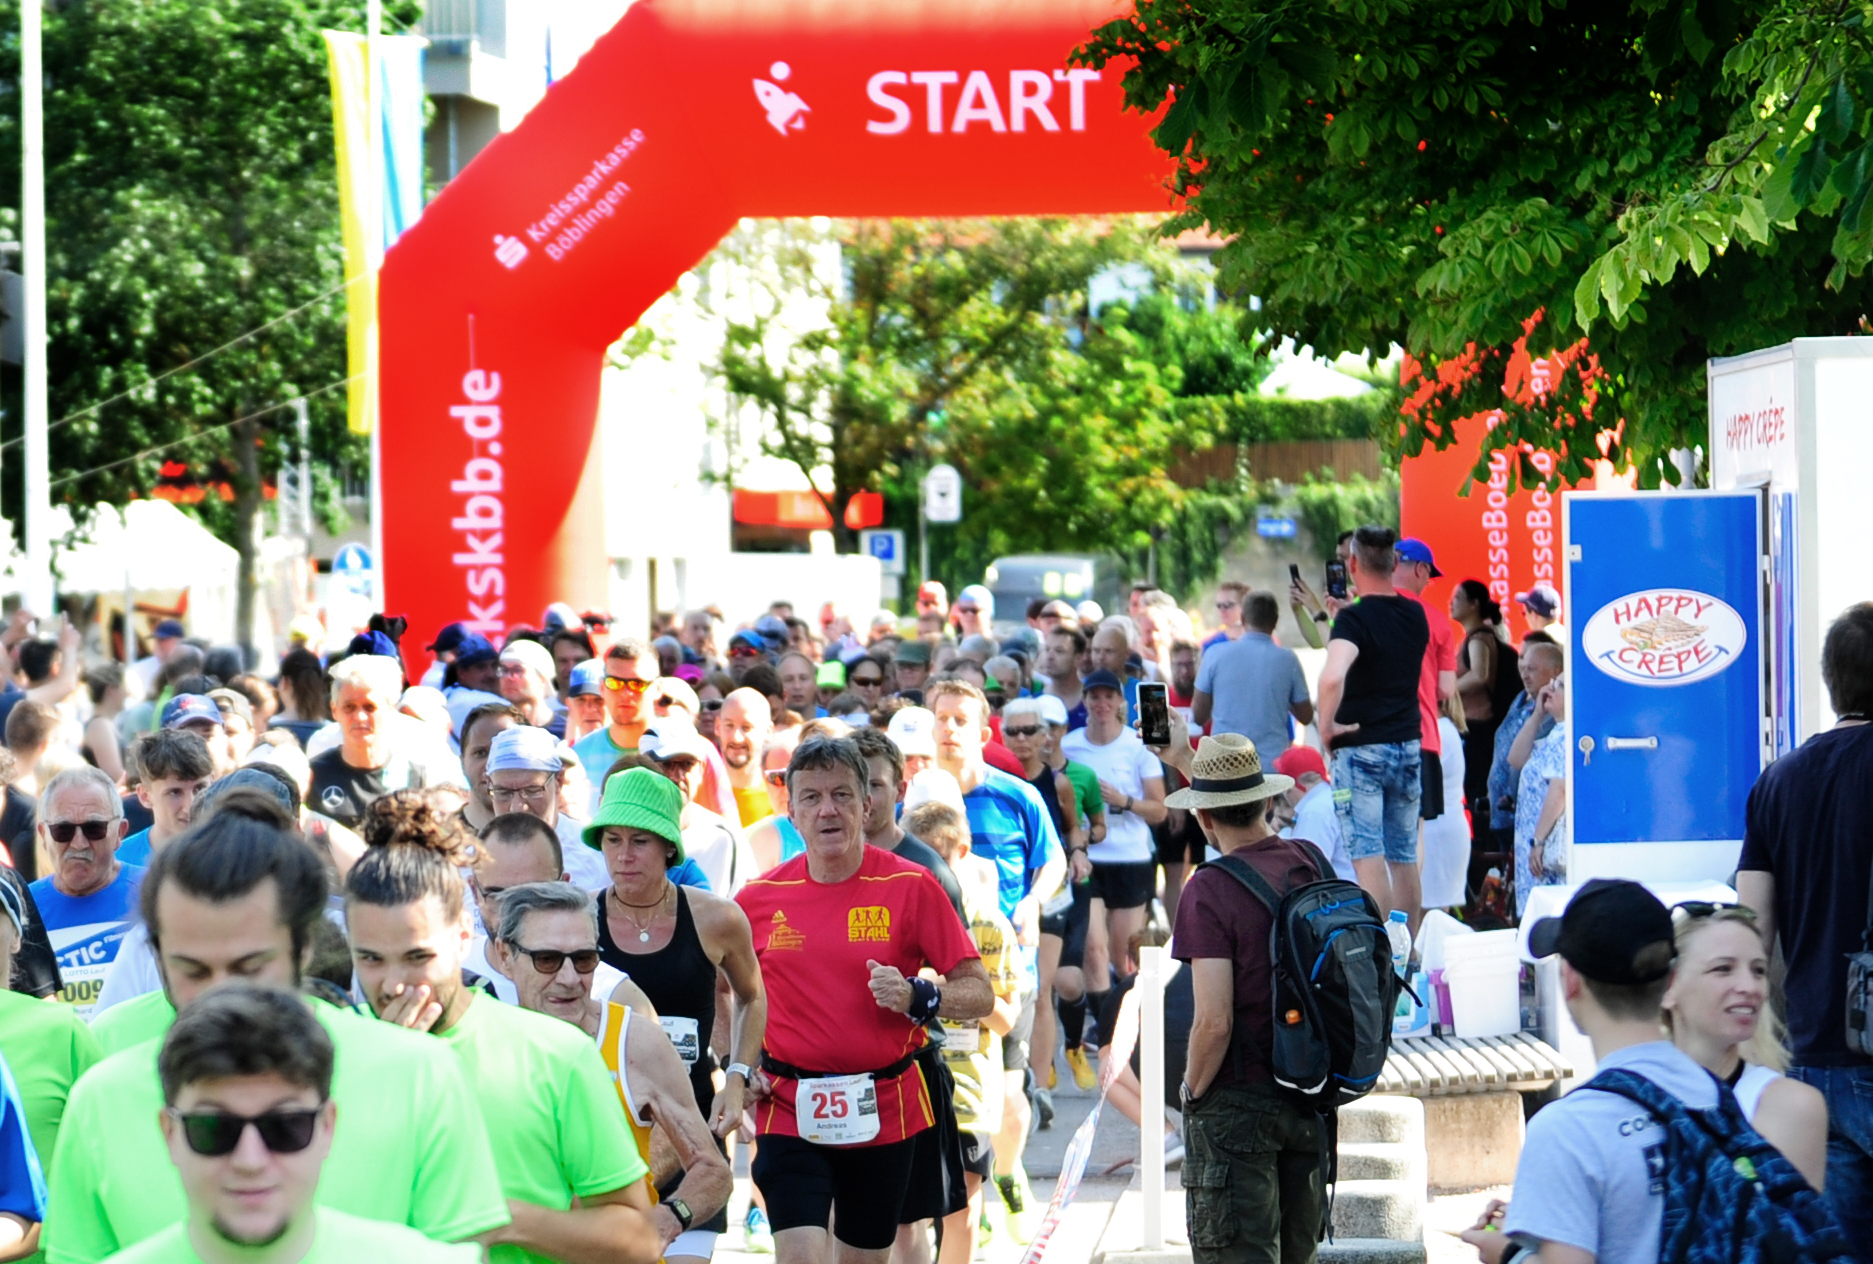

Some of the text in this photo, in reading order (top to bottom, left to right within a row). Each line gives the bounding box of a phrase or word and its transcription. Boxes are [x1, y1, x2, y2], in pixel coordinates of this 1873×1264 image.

[866, 69, 1102, 135] START
[526, 128, 645, 242] Kreissparkasse
[545, 181, 631, 261] Böblingen
[1726, 396, 1785, 451] HAPPY CRÊPE
[1613, 594, 1714, 625] HAPPY
[1618, 638, 1713, 676] CRÊPE
[848, 927, 889, 938] STAHL
[811, 1091, 848, 1119] 25
[817, 1122, 847, 1130] Andreas
